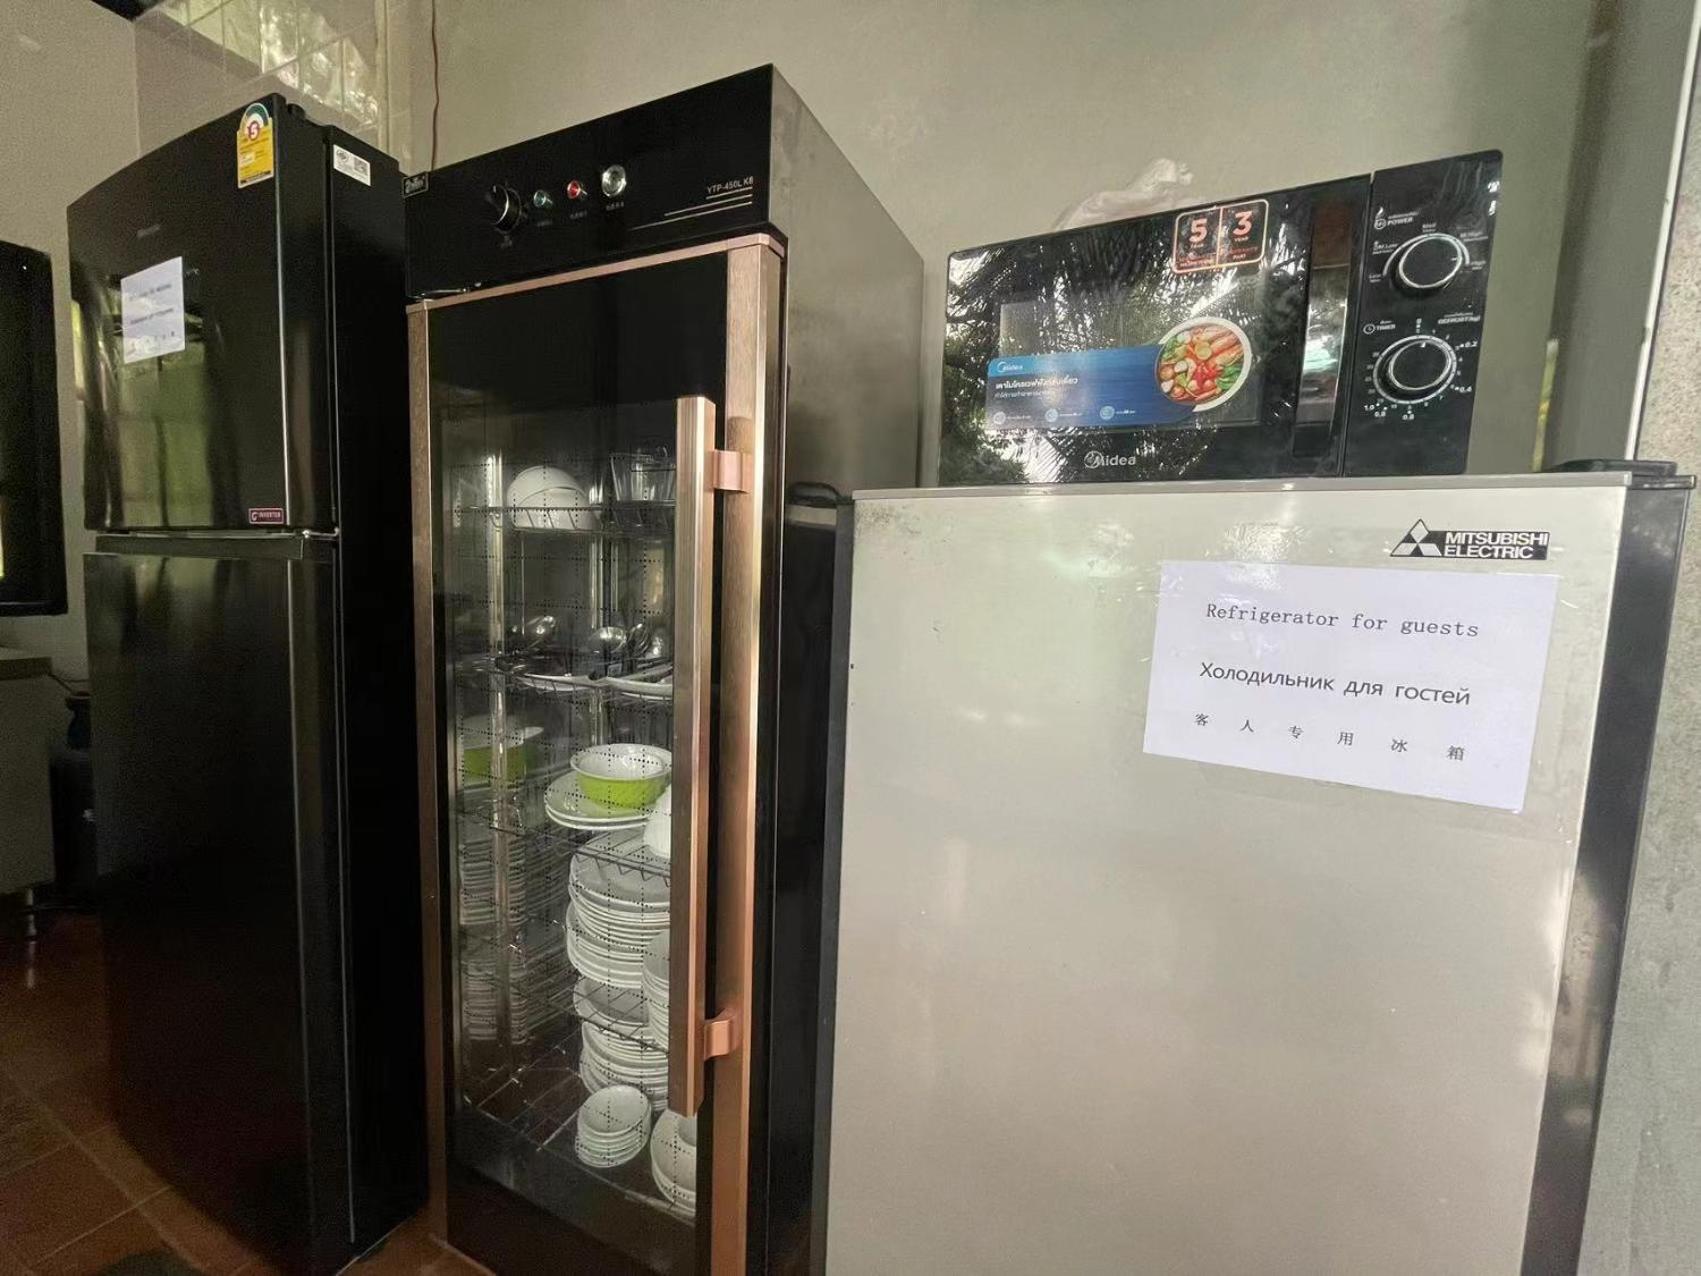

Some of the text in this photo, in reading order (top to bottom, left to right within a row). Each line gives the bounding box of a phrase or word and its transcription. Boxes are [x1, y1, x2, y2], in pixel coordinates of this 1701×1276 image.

[1189, 218, 1208, 243] 5
[1232, 211, 1252, 236] 3
[1091, 452, 1136, 467] Midea
[1445, 531, 1549, 546] MITSUBISHI
[1444, 544, 1534, 559] ELECTRIC
[1206, 602, 1479, 637] Refrigerator for guests
[1199, 662, 1470, 706] Холодильник для гостей
[1195, 713, 1465, 762] 客人专用冰箱
